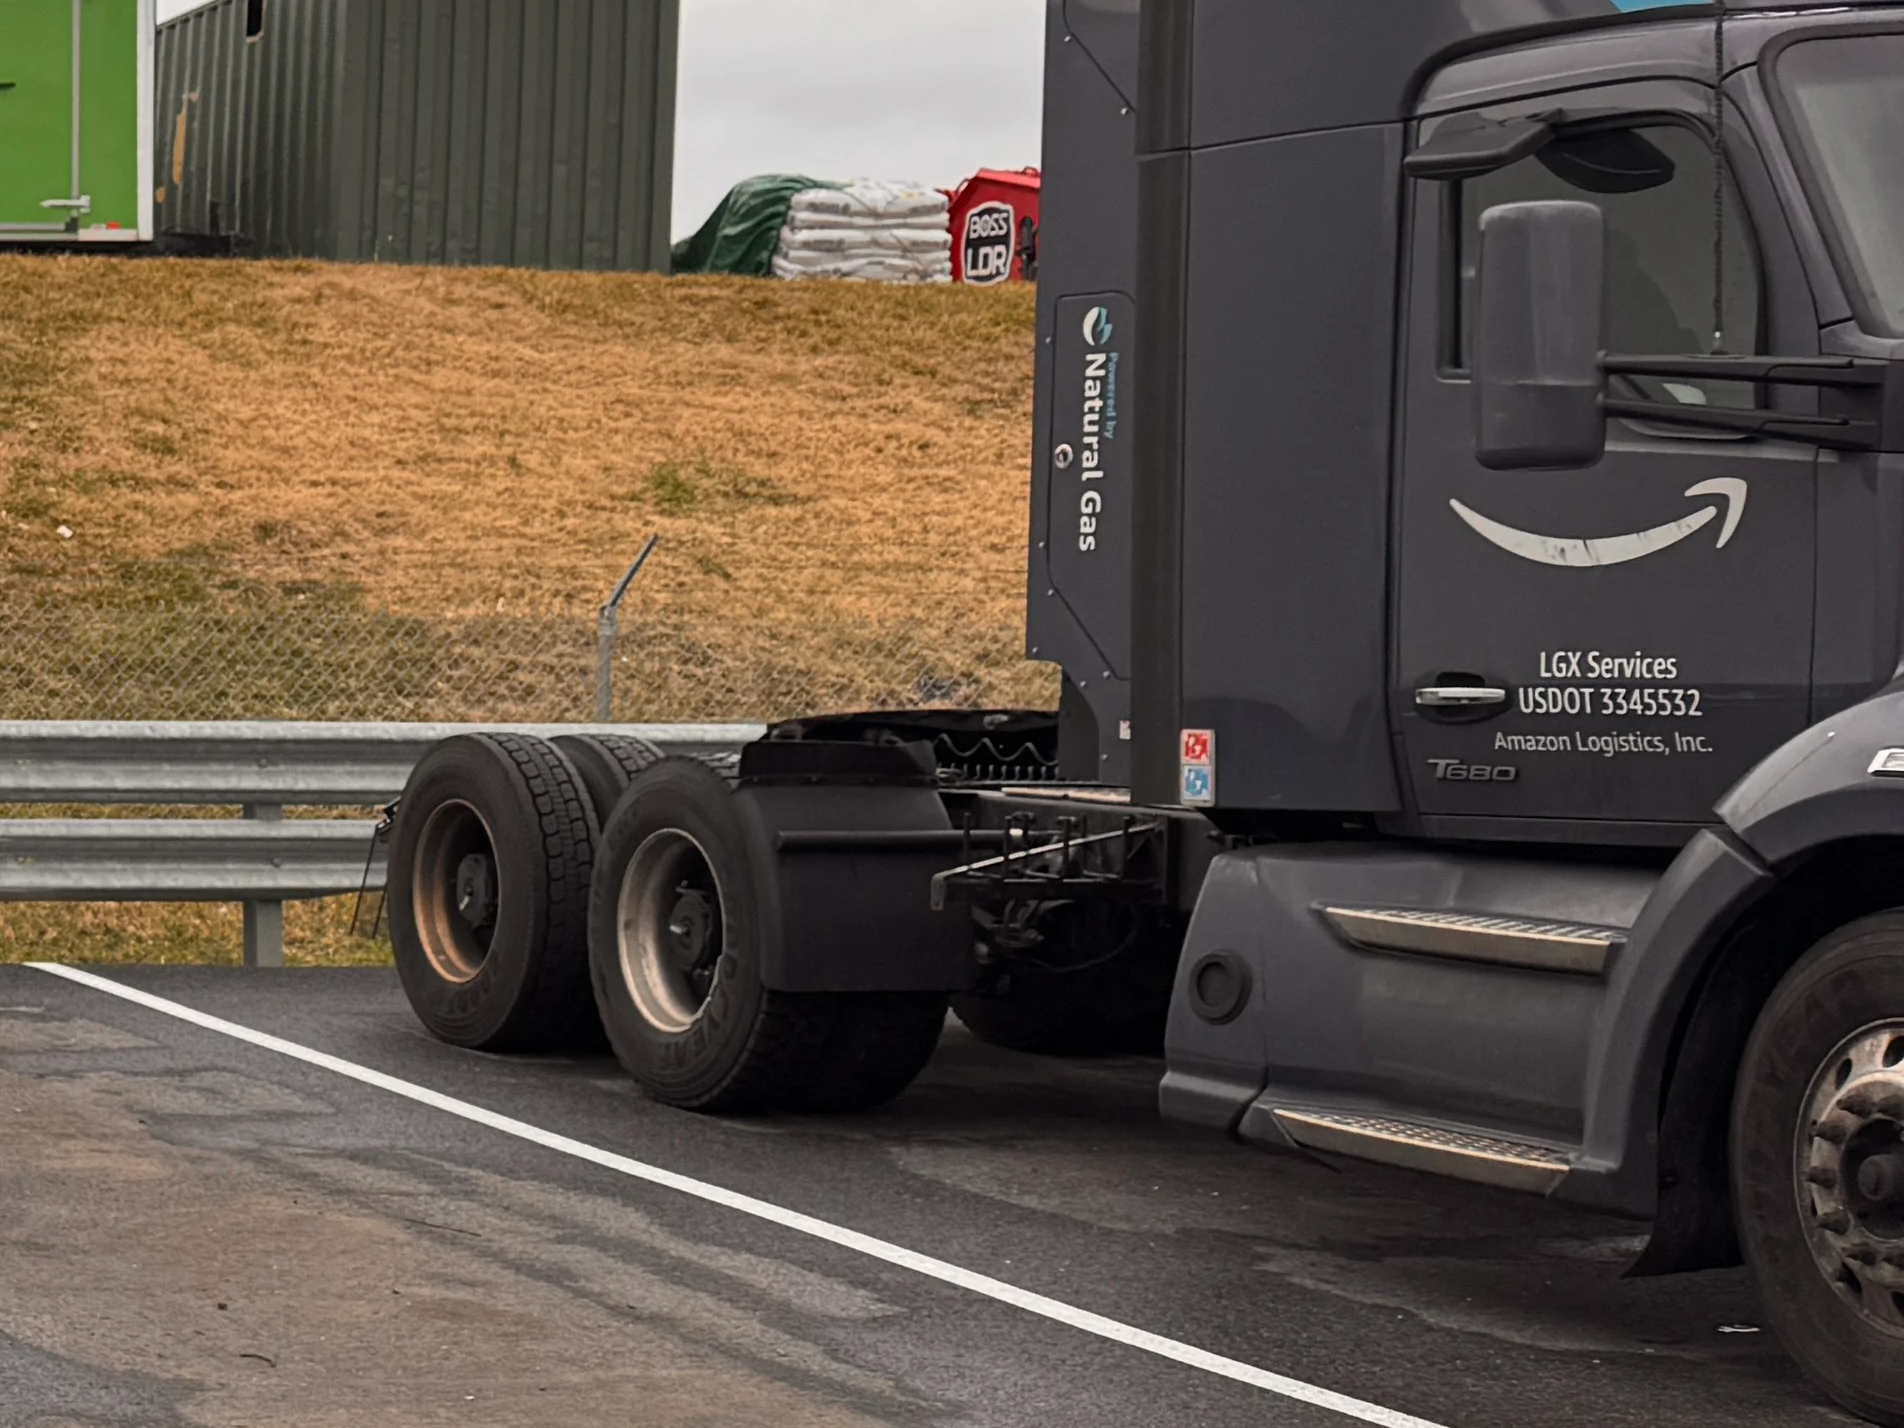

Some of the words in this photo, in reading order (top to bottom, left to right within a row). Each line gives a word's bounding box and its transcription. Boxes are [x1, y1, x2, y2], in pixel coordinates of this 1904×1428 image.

[969, 212, 1009, 240] BOSS
[966, 245, 1008, 277] LDR
[1106, 352, 1120, 416] Powered
[1081, 352, 1107, 481] Natural
[1103, 420, 1117, 439] by
[1079, 490, 1102, 552] Gas
[1540, 651, 1582, 678] LGX
[1587, 651, 1678, 679] Services
[1518, 687, 1594, 714] USDOT
[1600, 688, 1703, 716] 3345532
[1495, 732, 1571, 751] Amazon
[1576, 731, 1670, 757] Logistics,
[1675, 732, 1713, 753] Inc.
[1427, 759, 1517, 782] T680
